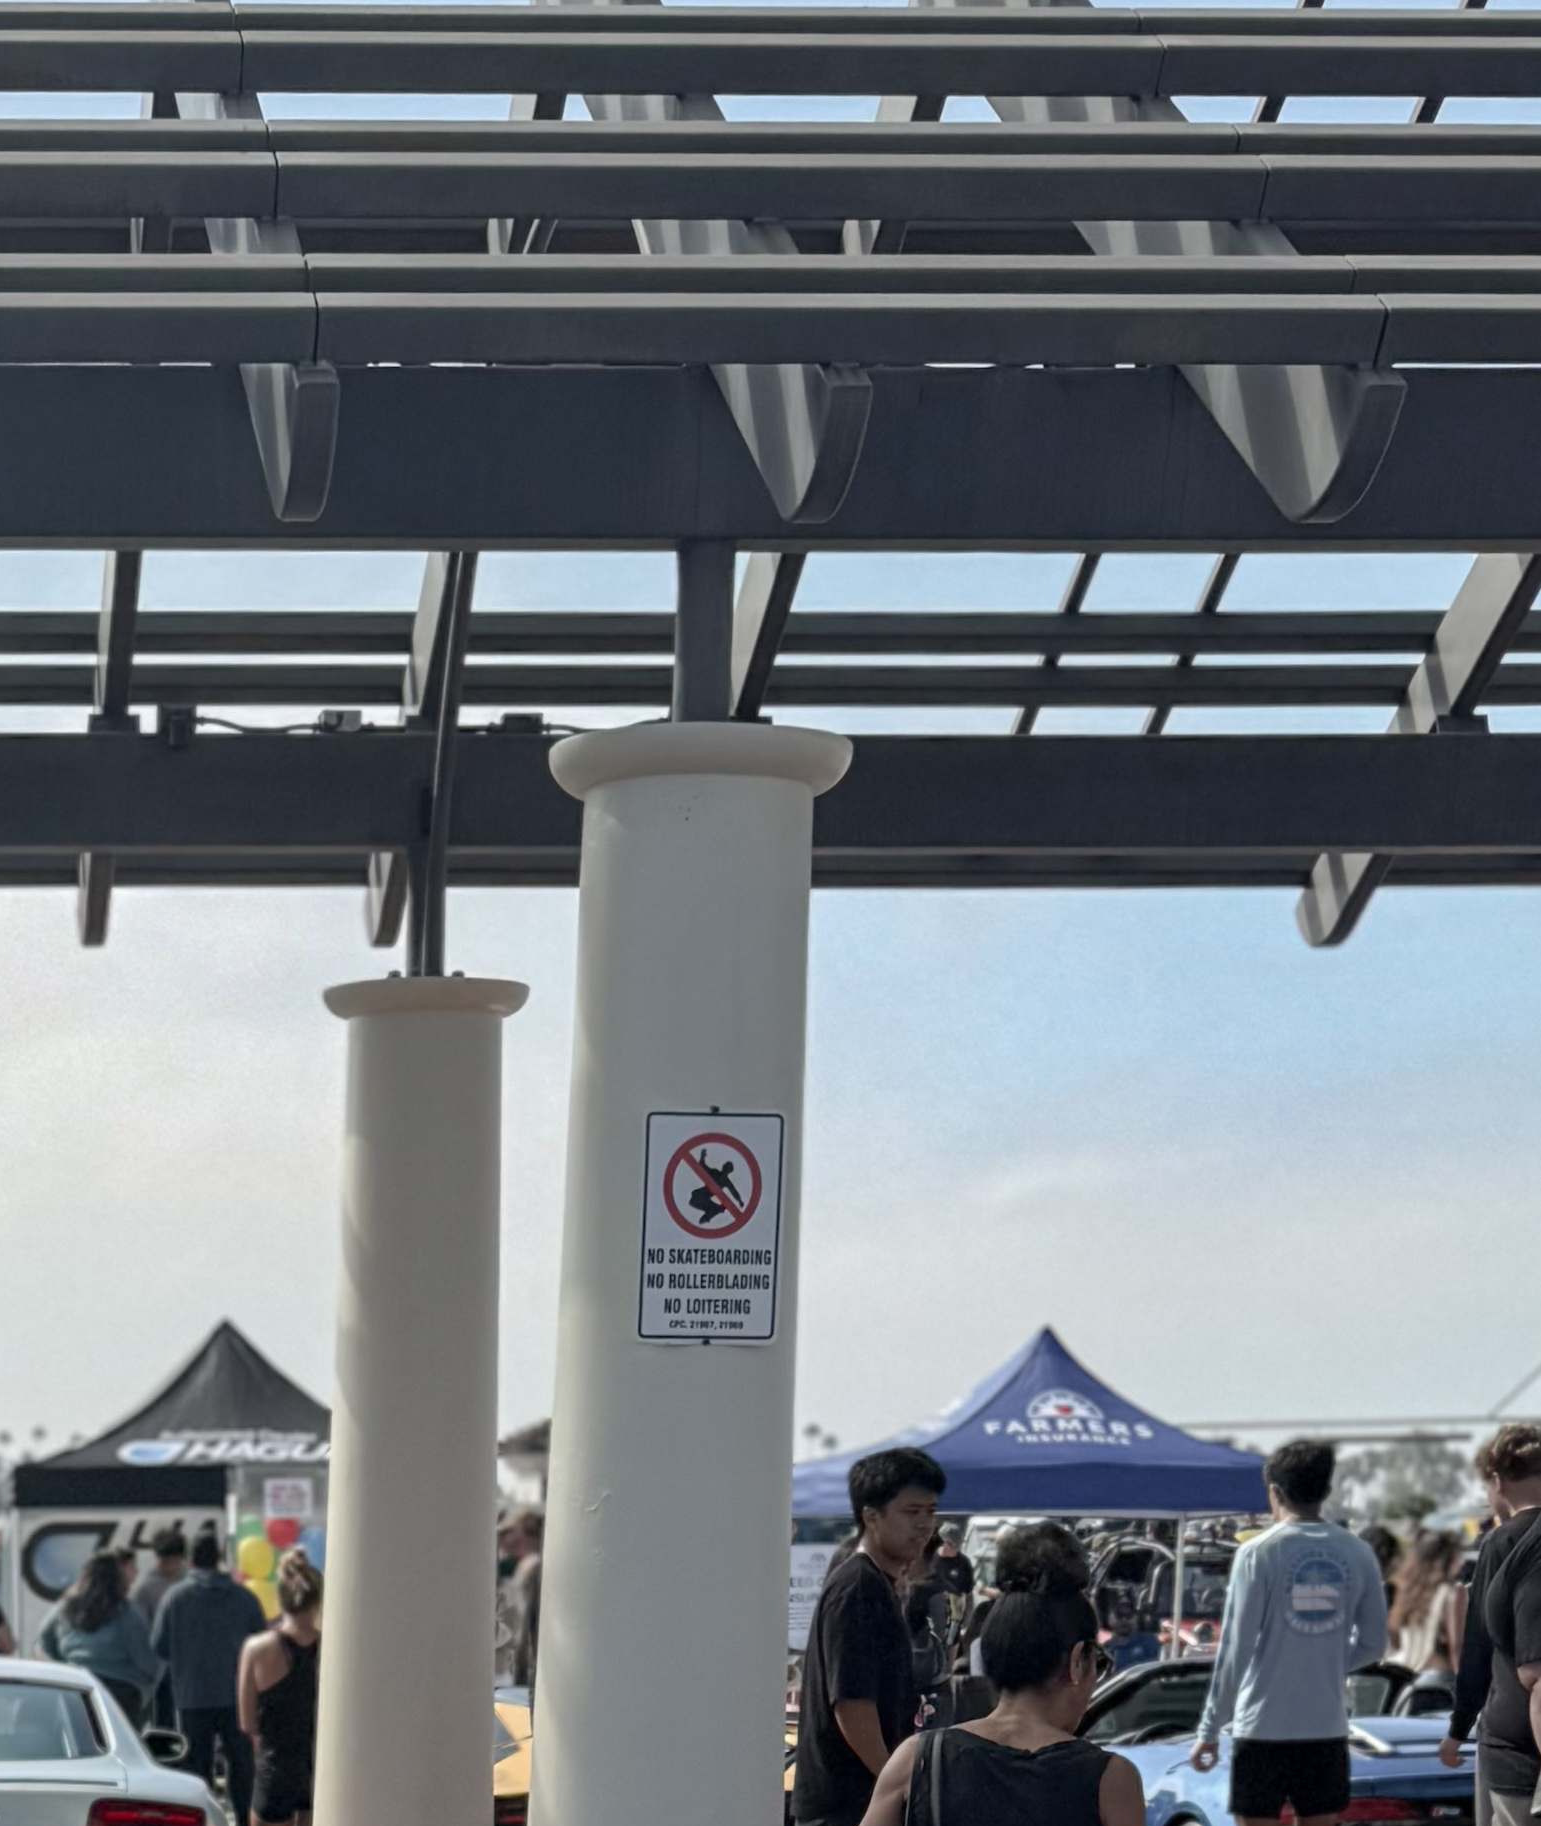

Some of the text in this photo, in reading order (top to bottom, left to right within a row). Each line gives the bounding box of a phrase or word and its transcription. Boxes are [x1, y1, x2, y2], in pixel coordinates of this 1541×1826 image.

[647, 1248, 772, 1266] NO SKATEBOARDING
[646, 1273, 770, 1290] NO ROLLERBLADING
[663, 1298, 751, 1315] NO LOITERING
[984, 1417, 1154, 1439] FARMERS
[1016, 1433, 1132, 1445] INSURANCE
